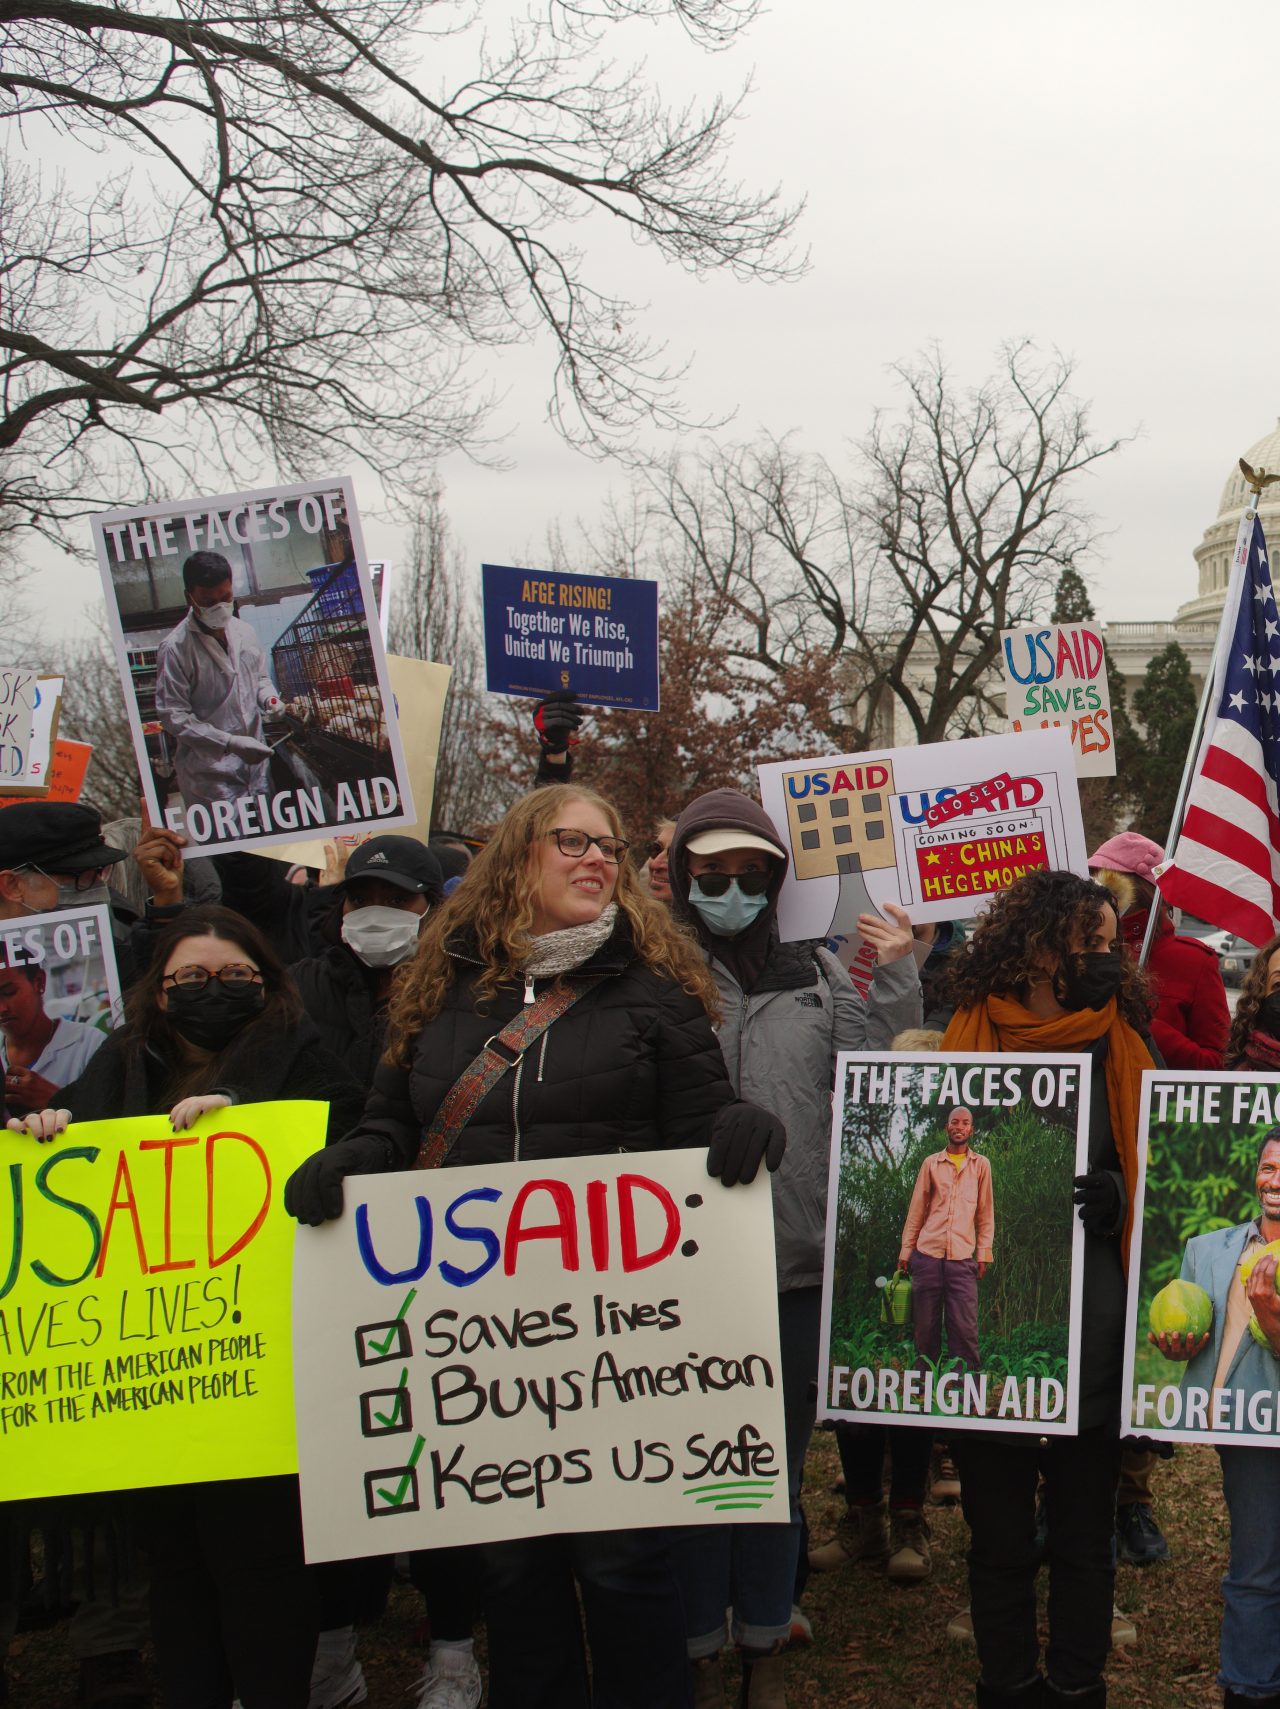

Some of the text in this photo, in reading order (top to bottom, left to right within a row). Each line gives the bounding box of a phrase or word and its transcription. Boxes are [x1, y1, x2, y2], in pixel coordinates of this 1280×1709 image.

[105, 492, 342, 562] THE FACES OF
[522, 579, 612, 611] AFGE RISING!
[506, 606, 630, 644] Together We Rise,
[504, 634, 633, 673] United We Triumph
[1004, 628, 1104, 684] USAID
[1024, 685, 1102, 716] SAVES
[787, 765, 889, 799] USAID
[928, 780, 1006, 821] CLOSED
[164, 776, 399, 842] FOREIGN AID
[919, 829, 976, 846] COMING
[960, 835, 1042, 866] CHINA'S
[54, 920, 96, 959] OF
[849, 1065, 1077, 1108] THE FACES OF
[1154, 1084, 1220, 1124] THE
[355, 1173, 704, 1288] USAID:
[120, 1264, 242, 1341] LIVES!
[593, 1294, 682, 1338] lives
[54, 1361, 97, 1391] THE
[102, 1343, 203, 1386] AMERICAN
[208, 1332, 267, 1366] PEOPLE
[1, 1369, 259, 1434] FOR THE AMERICAN PEOPLE
[431, 1351, 775, 1430] Buys American
[831, 1365, 1064, 1420] FOREIGN AID
[430, 1444, 594, 1510] Keeps
